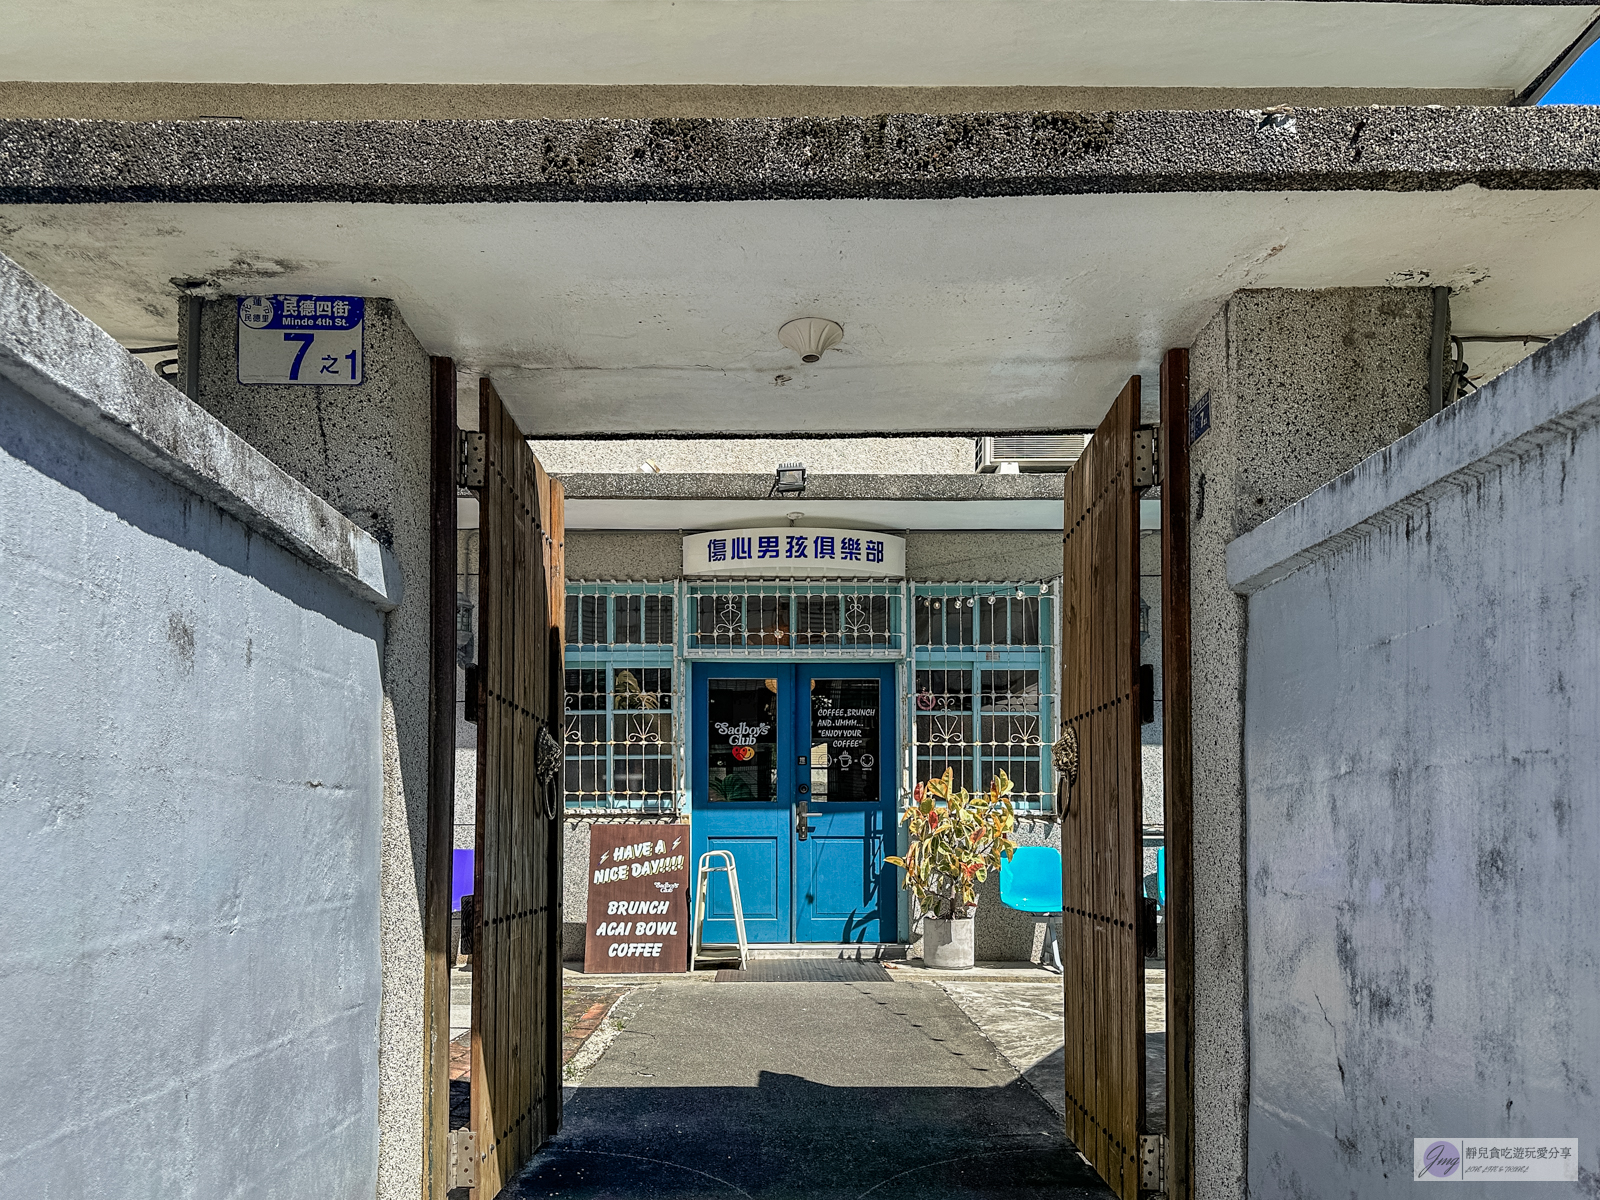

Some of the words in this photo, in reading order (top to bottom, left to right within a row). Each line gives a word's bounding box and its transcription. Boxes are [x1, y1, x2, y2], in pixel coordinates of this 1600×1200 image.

[282, 299, 349, 316] 民德四街
[282, 318, 314, 326] Minde
[316, 318, 333, 326] 4th
[335, 318, 349, 327] St.
[707, 535, 885, 564] 傷心男孩俱樂部
[728, 734, 757, 746] Club
[843, 729, 862, 737] YOUR
[613, 841, 653, 862] HAVE
[654, 839, 666, 855] A
[593, 865, 630, 885] NICE
[631, 855, 685, 878] DAY!!!!
[607, 900, 670, 916] BRUNCH
[595, 922, 632, 936] ACAI
[635, 922, 678, 936] BOWL
[608, 943, 663, 957] COFFEE
